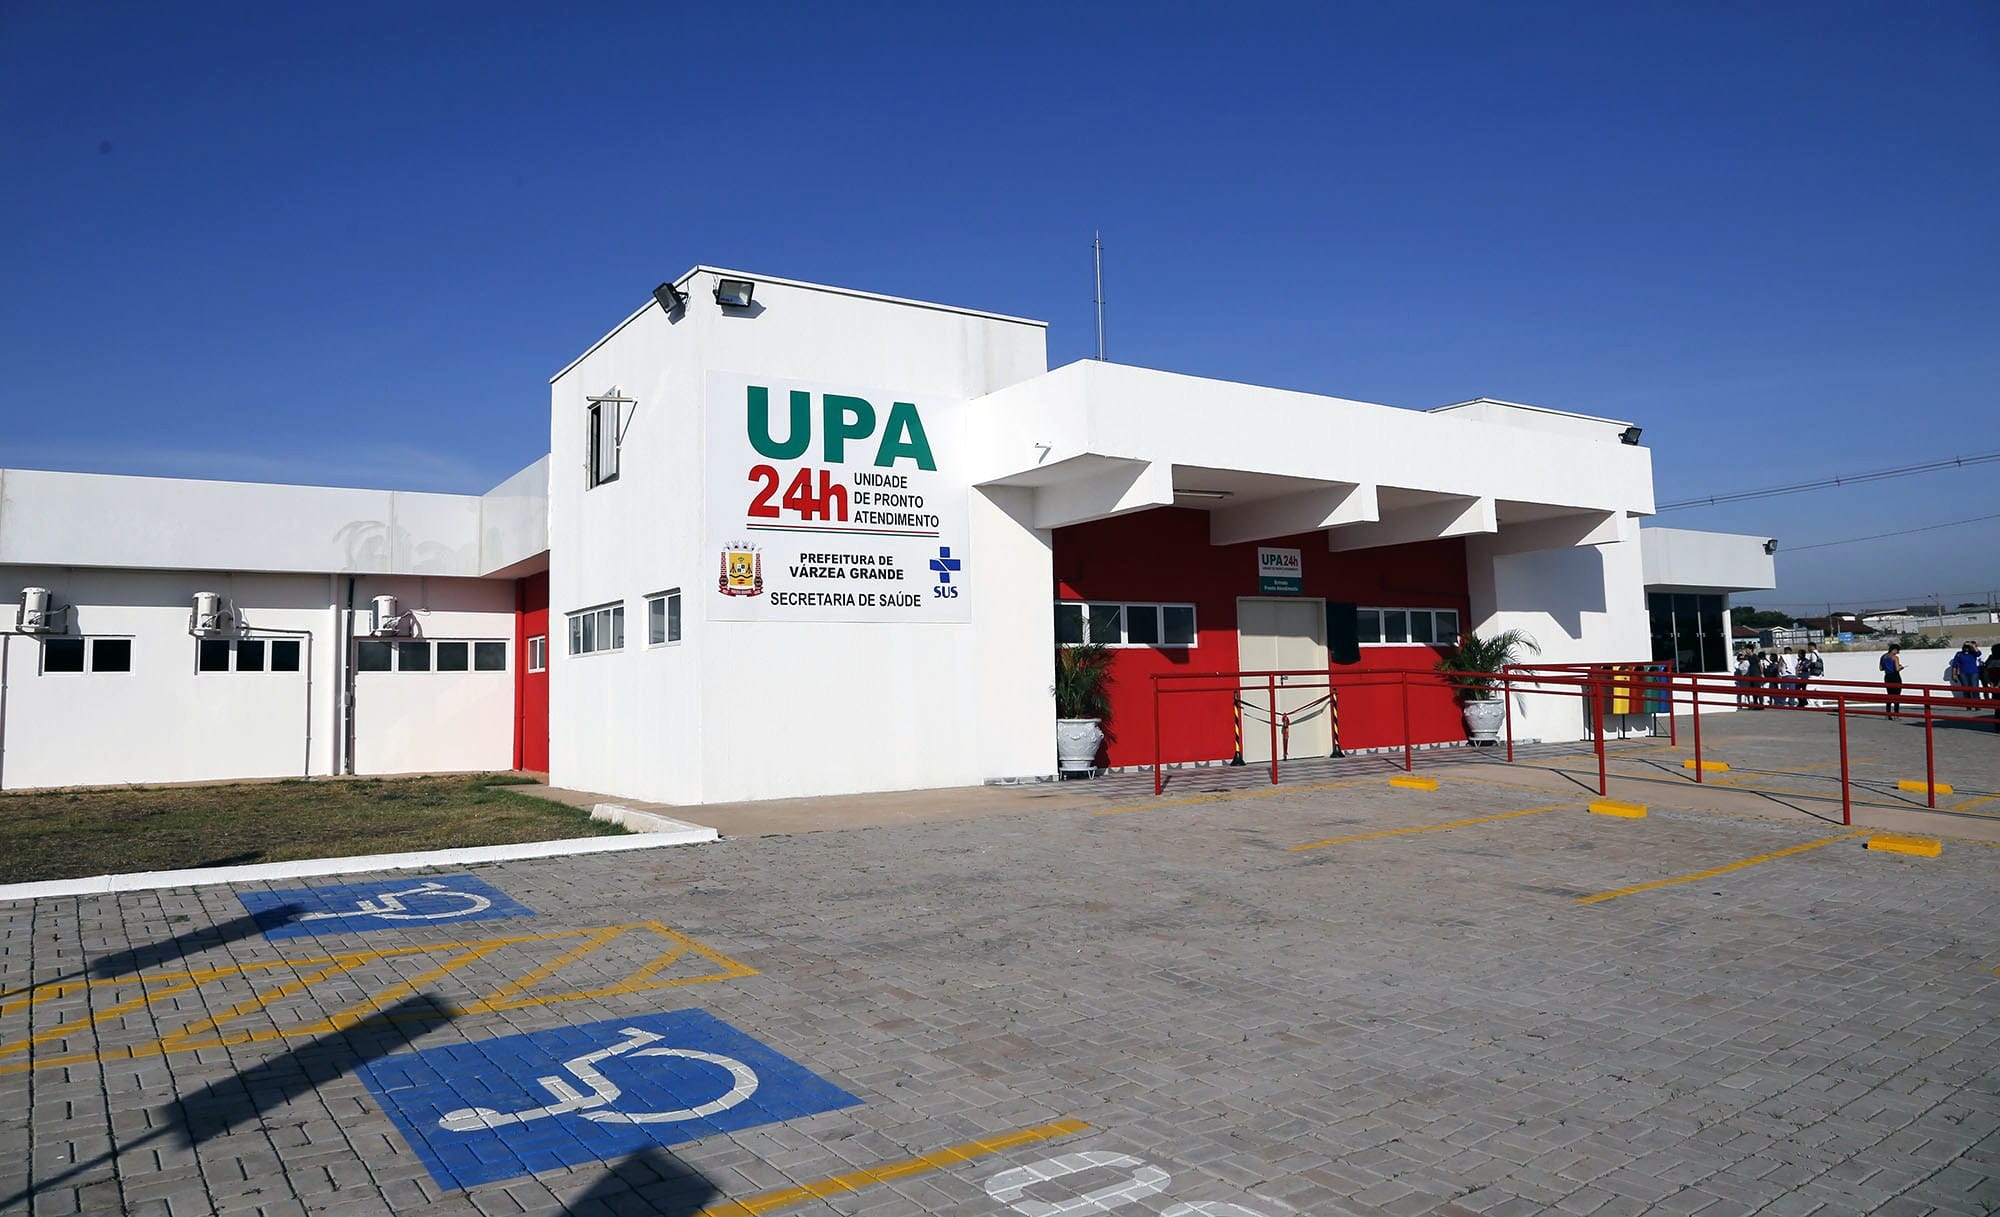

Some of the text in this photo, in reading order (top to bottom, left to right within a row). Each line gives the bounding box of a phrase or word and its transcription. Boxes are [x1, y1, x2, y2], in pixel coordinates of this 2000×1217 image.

[747, 385, 937, 472] UPA
[854, 472, 908, 489] UNIDADE
[747, 464, 848, 521] 24h
[854, 491, 924, 509] DE PRONTO
[854, 510, 939, 528] ATENDIMENTO
[800, 552, 893, 566] PREFEITURA DE
[1262, 553, 1283, 566] UPA
[790, 564, 904, 580] VÁRZEA GRANDE
[770, 591, 855, 606] SECRETARIA
[858, 593, 875, 607] DE
[879, 590, 921, 608] SAÚDE
[933, 585, 958, 599] SUS
